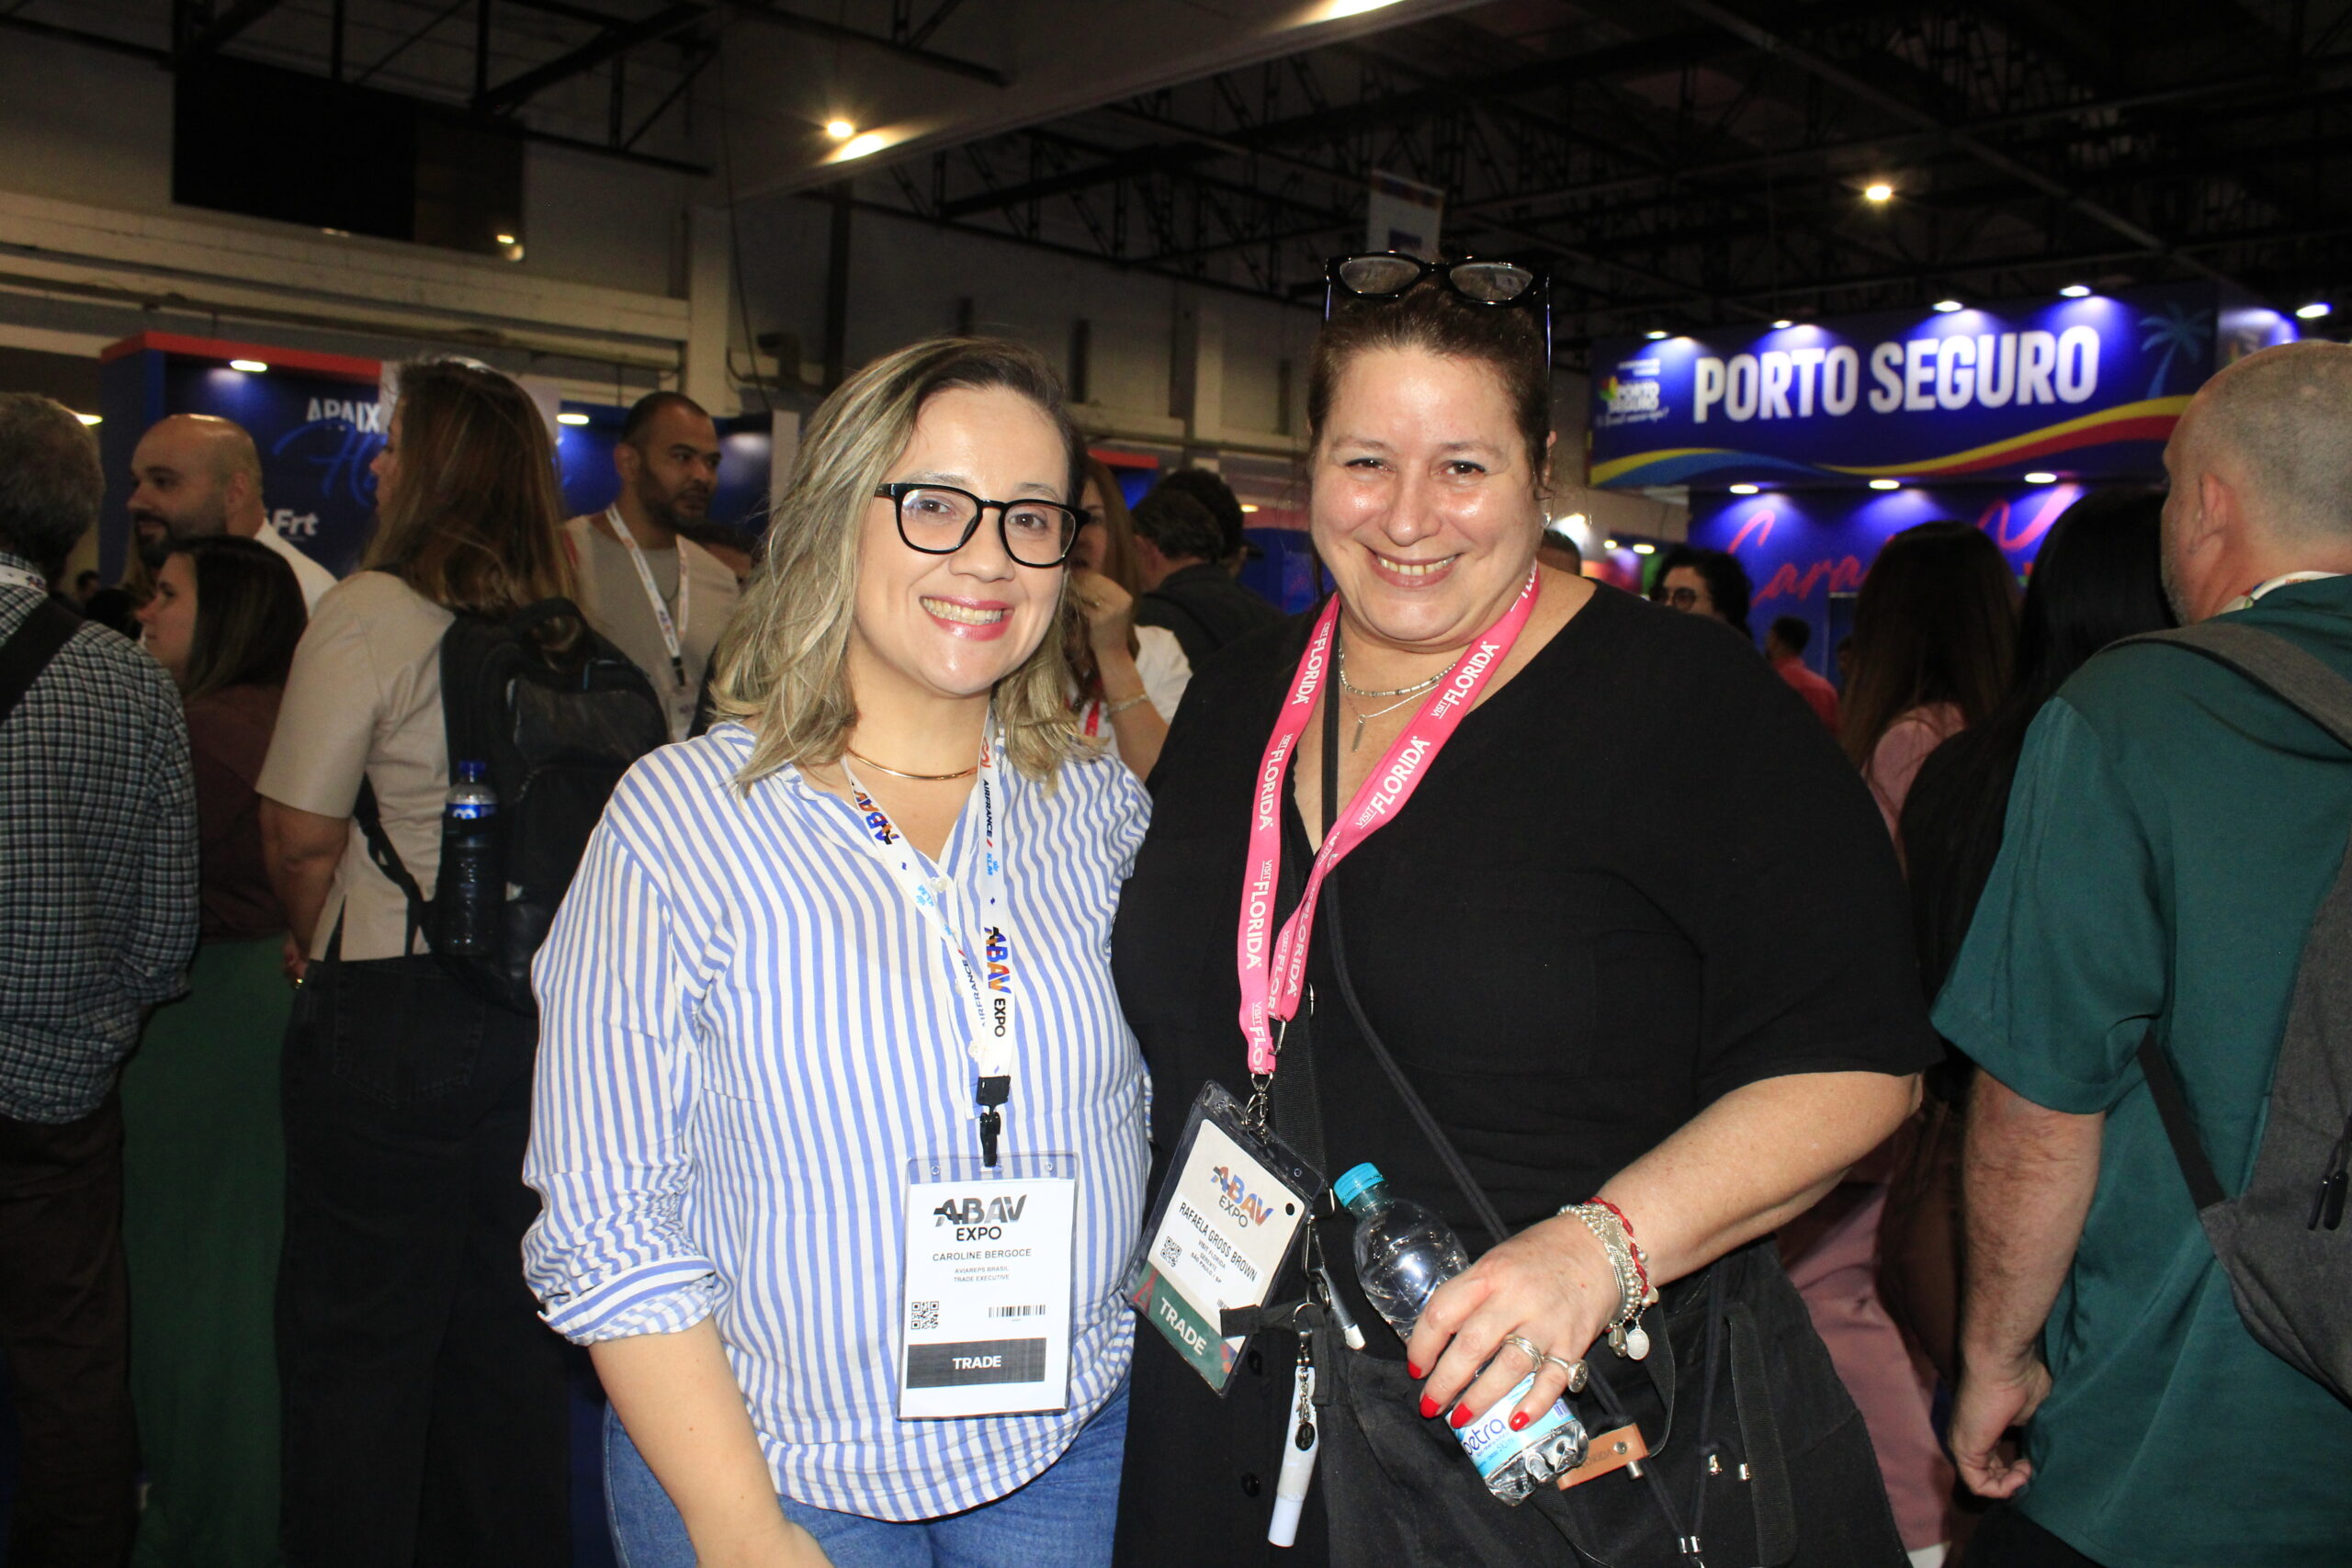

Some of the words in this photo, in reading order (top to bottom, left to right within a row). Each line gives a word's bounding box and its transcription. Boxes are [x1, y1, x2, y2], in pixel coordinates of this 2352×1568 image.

[1693, 345, 1860, 423] PORTO
[1869, 325, 2100, 413] SEGURO
[1292, 637, 1328, 705] FLORIDA
[1430, 700, 1449, 718] VISIT
[1442, 641, 1500, 706] FLORIDA
[1278, 733, 1294, 750] VISIT
[1259, 749, 1285, 831] FLORIDA
[1355, 806, 1376, 829] VISIT
[1370, 736, 1431, 816] FLORIDA
[1261, 860, 1273, 881] VISIT
[1246, 881, 1271, 970] FLORIDA
[1287, 902, 1312, 997] FLORIDA
[984, 926, 1012, 994] ABAV
[994, 998, 1006, 1037] EXPO
[1252, 1001, 1262, 1026] VISIT
[933, 1194, 1027, 1227] ABAV
[1211, 1166, 1273, 1226] ABAV
[1218, 1195, 1248, 1227] EXPO
[933, 1251, 982, 1261] CAROLINE
[985, 1248, 1032, 1259] BERGOCE
[956, 1226, 1001, 1241] EXPO
[1179, 1201, 1209, 1235] RAFAELA
[1208, 1230, 1231, 1257] GROSS
[1231, 1251, 1257, 1281] BROWN
[1159, 1297, 1207, 1356] TRADE
[952, 1355, 1001, 1370] TRADE
